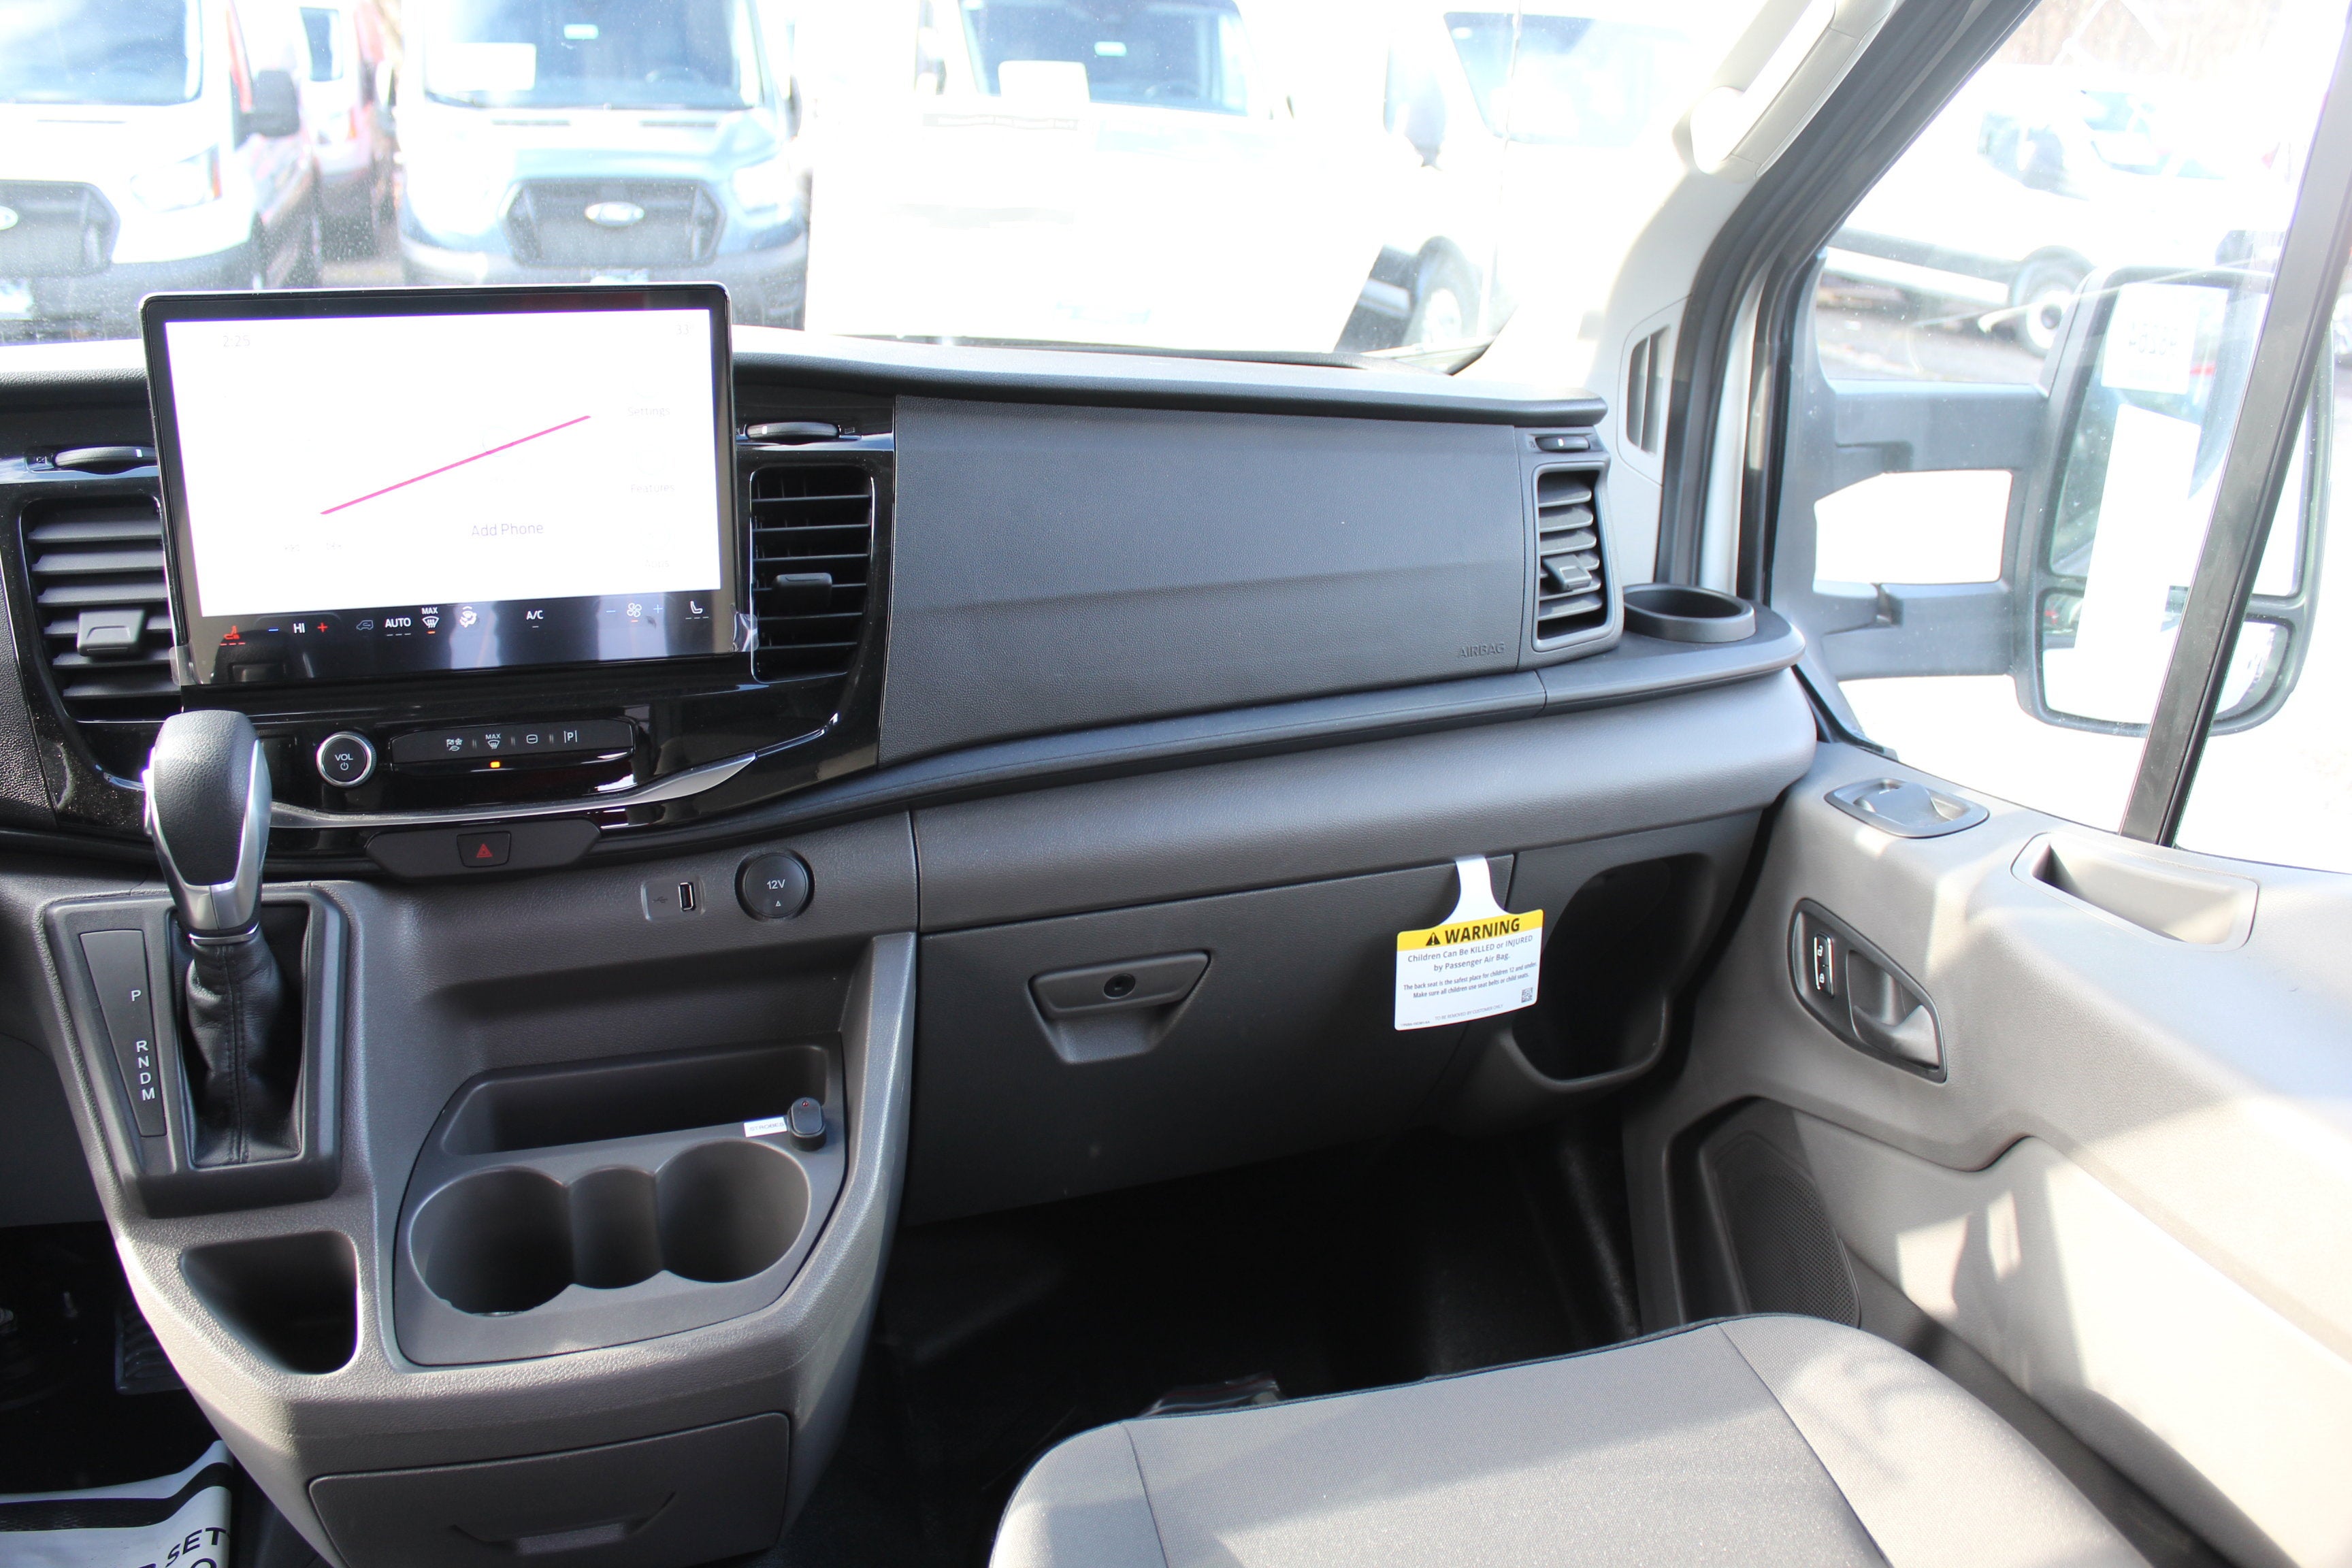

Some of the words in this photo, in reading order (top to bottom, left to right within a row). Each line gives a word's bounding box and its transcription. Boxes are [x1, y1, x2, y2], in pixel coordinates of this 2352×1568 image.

[223, 335, 250, 347] 2:25
[472, 523, 497, 536] Add
[501, 523, 544, 535] Phone
[526, 610, 544, 620] A/C
[293, 623, 306, 634] HI
[385, 618, 412, 628] AUTO
[1460, 641, 1505, 657] AIRBAG
[766, 879, 785, 889] 12V
[1445, 917, 1520, 944] WARNING
[1407, 952, 1441, 962] Children
[1443, 950, 1457, 958] Can
[1470, 944, 1494, 953] KILLED
[1505, 935, 1533, 947] INJURED
[1434, 964, 1443, 973] by
[1445, 958, 1482, 970] Passenger
[1484, 955, 1494, 963] Air
[1496, 953, 1510, 962] Bag.
[1454, 976, 1468, 984] safest
[1469, 975, 1482, 984] place
[1490, 968, 1508, 978] children
[1524, 962, 1537, 970] under.
[1448, 984, 1467, 994] children
[1506, 974, 1516, 982] child
[1517, 972, 1529, 980] seats.
[131, 990, 142, 1002] P
[1447, 1011, 1467, 1019] REMOVED
[1472, 1006, 1492, 1015] CUSTOMER
[135, 1040, 148, 1053] R
[137, 1056, 150, 1068] N
[140, 1072, 151, 1085] D
[142, 1087, 155, 1101] M
[165, 1526, 230, 1568] SET
